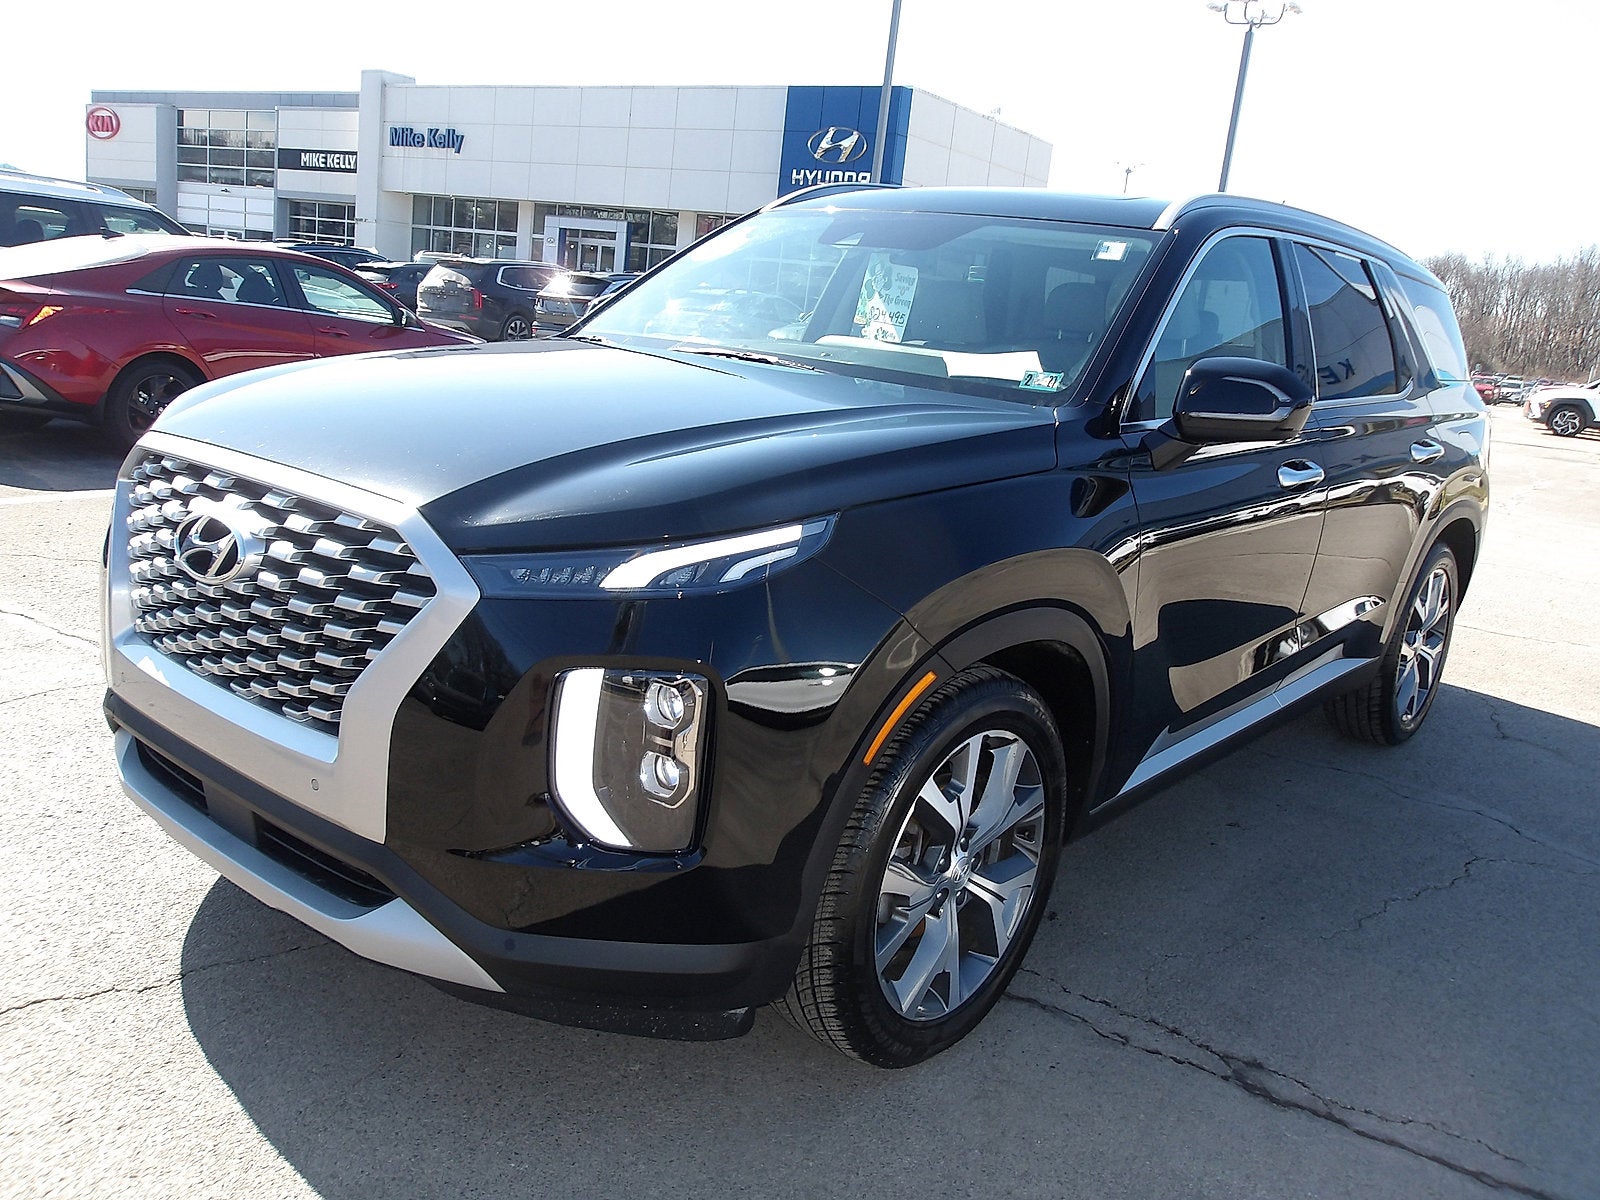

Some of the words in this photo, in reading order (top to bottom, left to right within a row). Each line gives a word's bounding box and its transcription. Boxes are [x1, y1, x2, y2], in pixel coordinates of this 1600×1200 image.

[89, 114, 114, 132] KIA
[389, 126, 425, 148] Mike
[427, 127, 465, 154] Kelly
[300, 152, 326, 168] MIKE
[326, 153, 357, 170] KELLY
